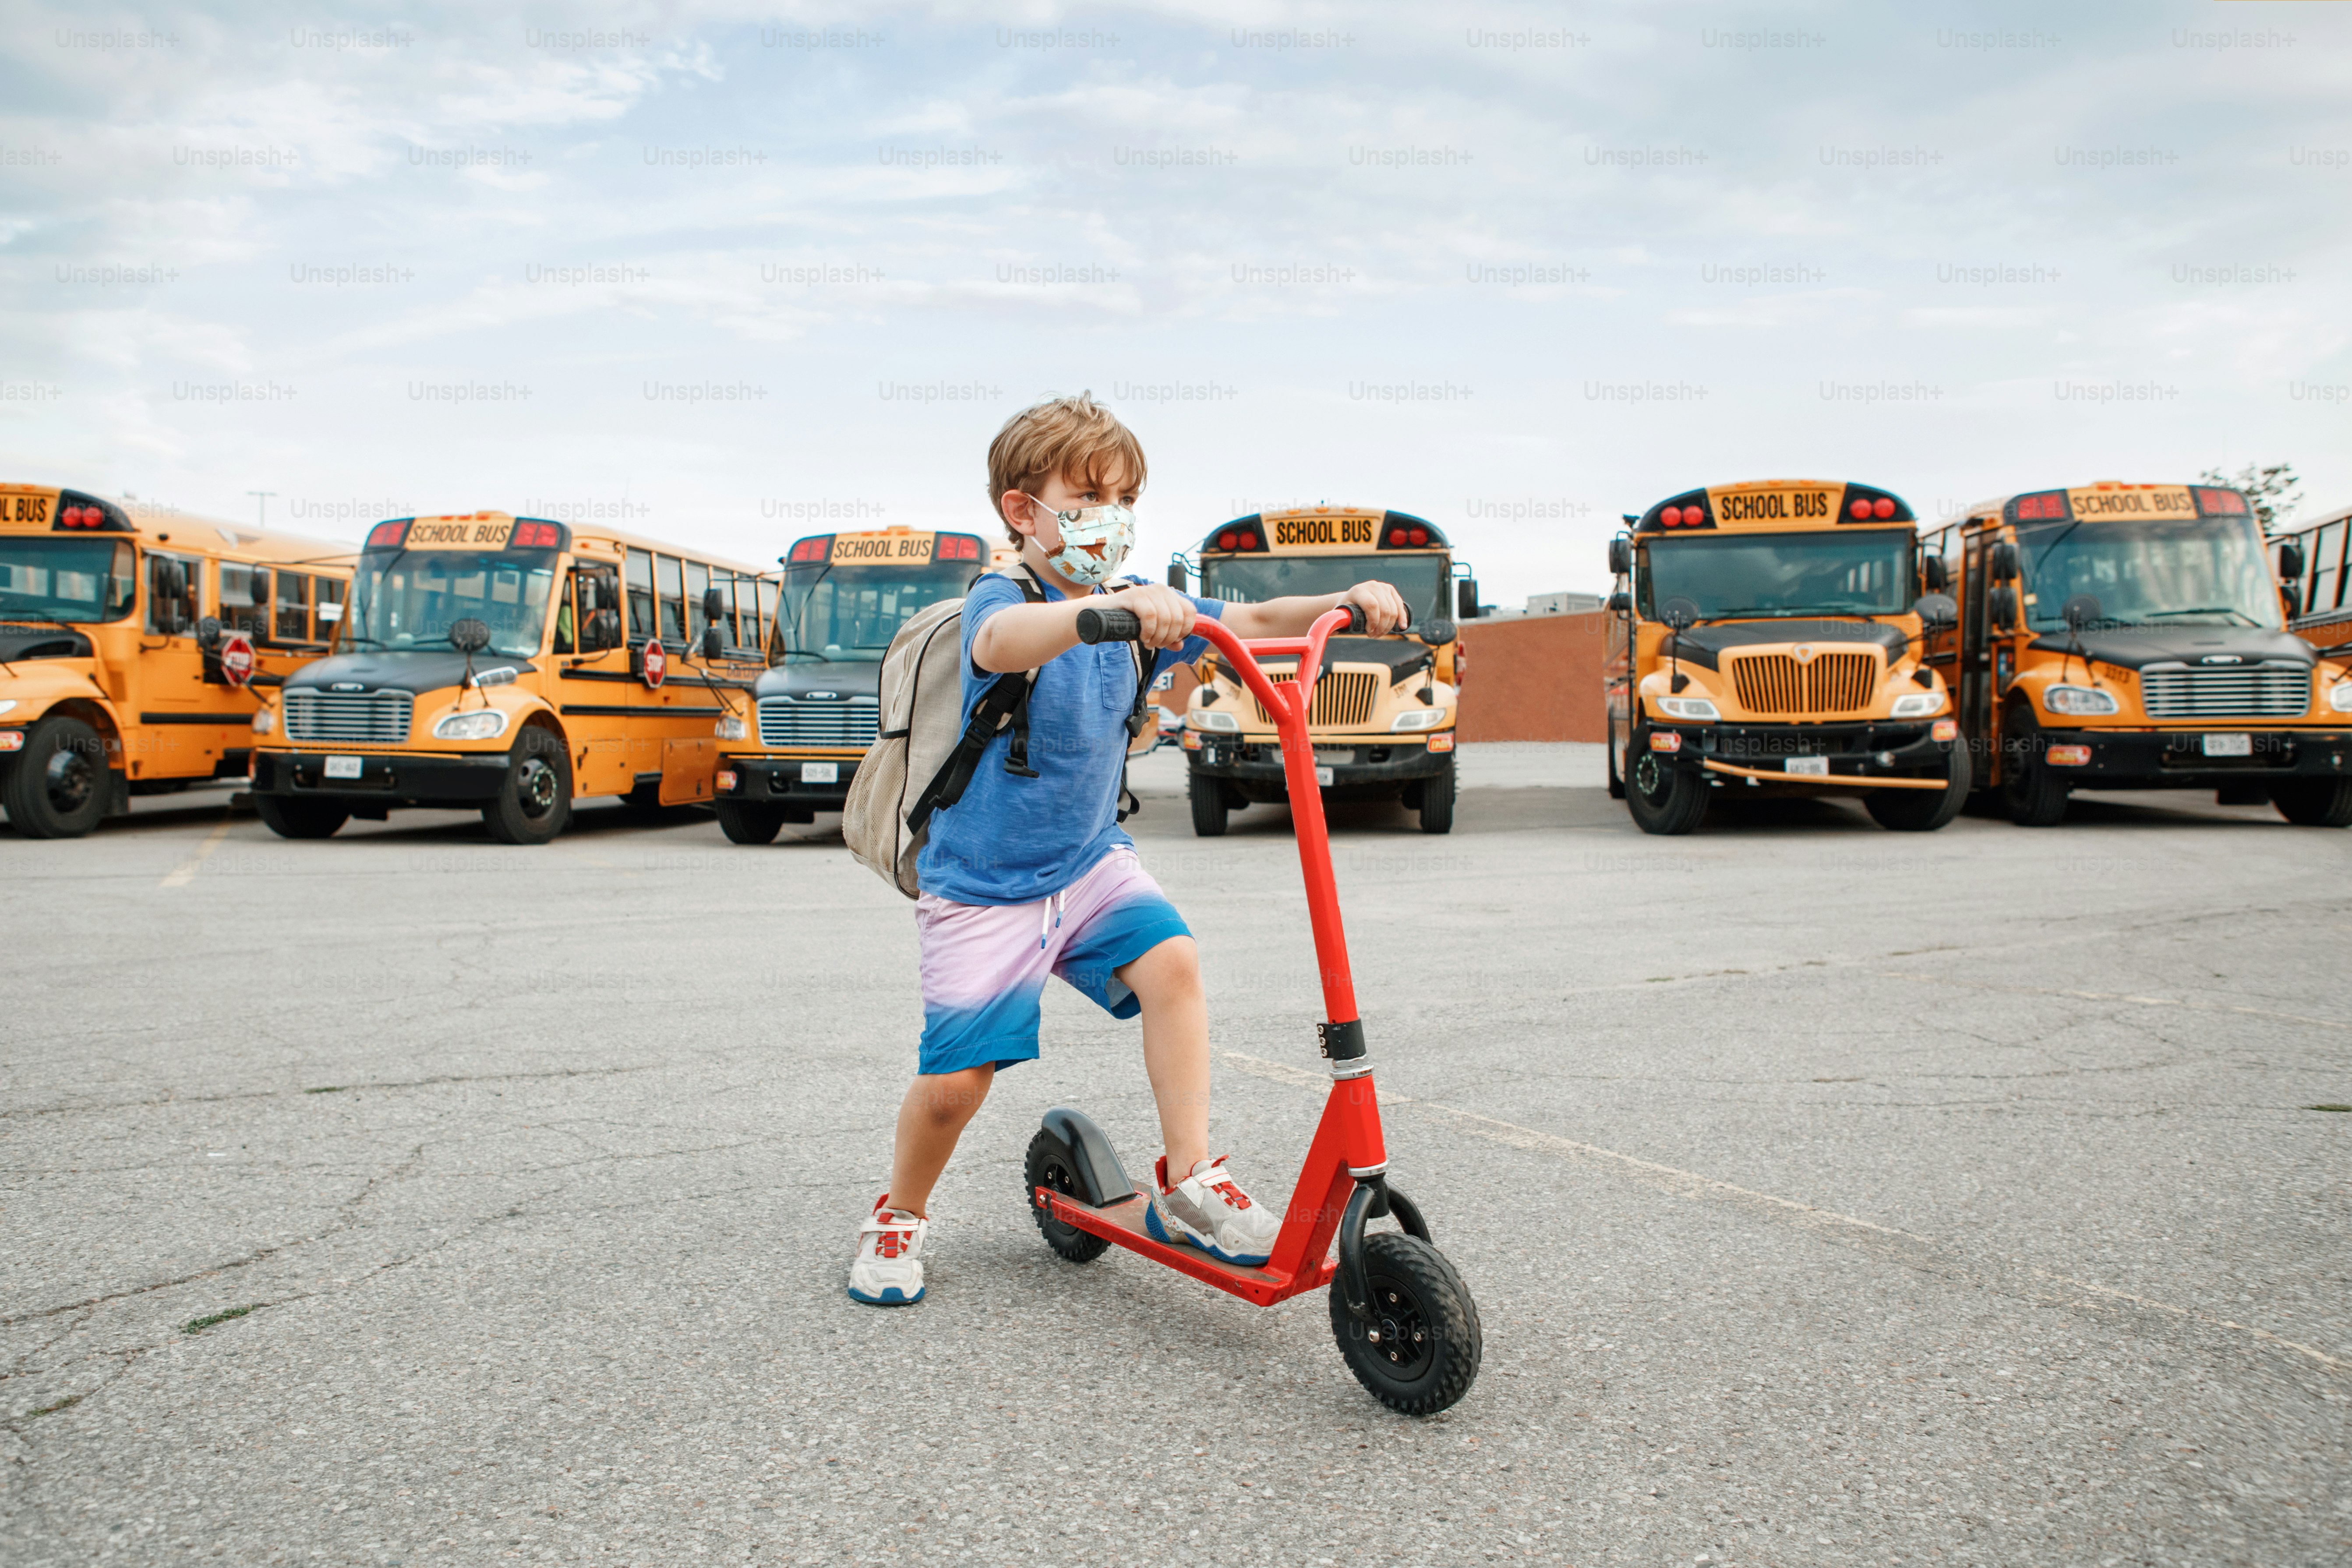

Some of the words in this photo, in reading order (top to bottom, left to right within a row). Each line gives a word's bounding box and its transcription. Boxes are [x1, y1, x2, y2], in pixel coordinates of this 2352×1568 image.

[16, 498, 46, 521] BUS
[1722, 494, 1788, 520] SCHOOL
[1794, 492, 1827, 517] BUS
[2073, 494, 2150, 514] SCHOOL
[2153, 492, 2190, 512] BUS
[410, 525, 468, 543] SCHOOL
[474, 525, 509, 543] BUS
[1277, 521, 1337, 544] SCHOOL
[1342, 520, 1371, 543] BUS
[834, 540, 893, 558] SCHOOL
[898, 540, 931, 557] BUS
